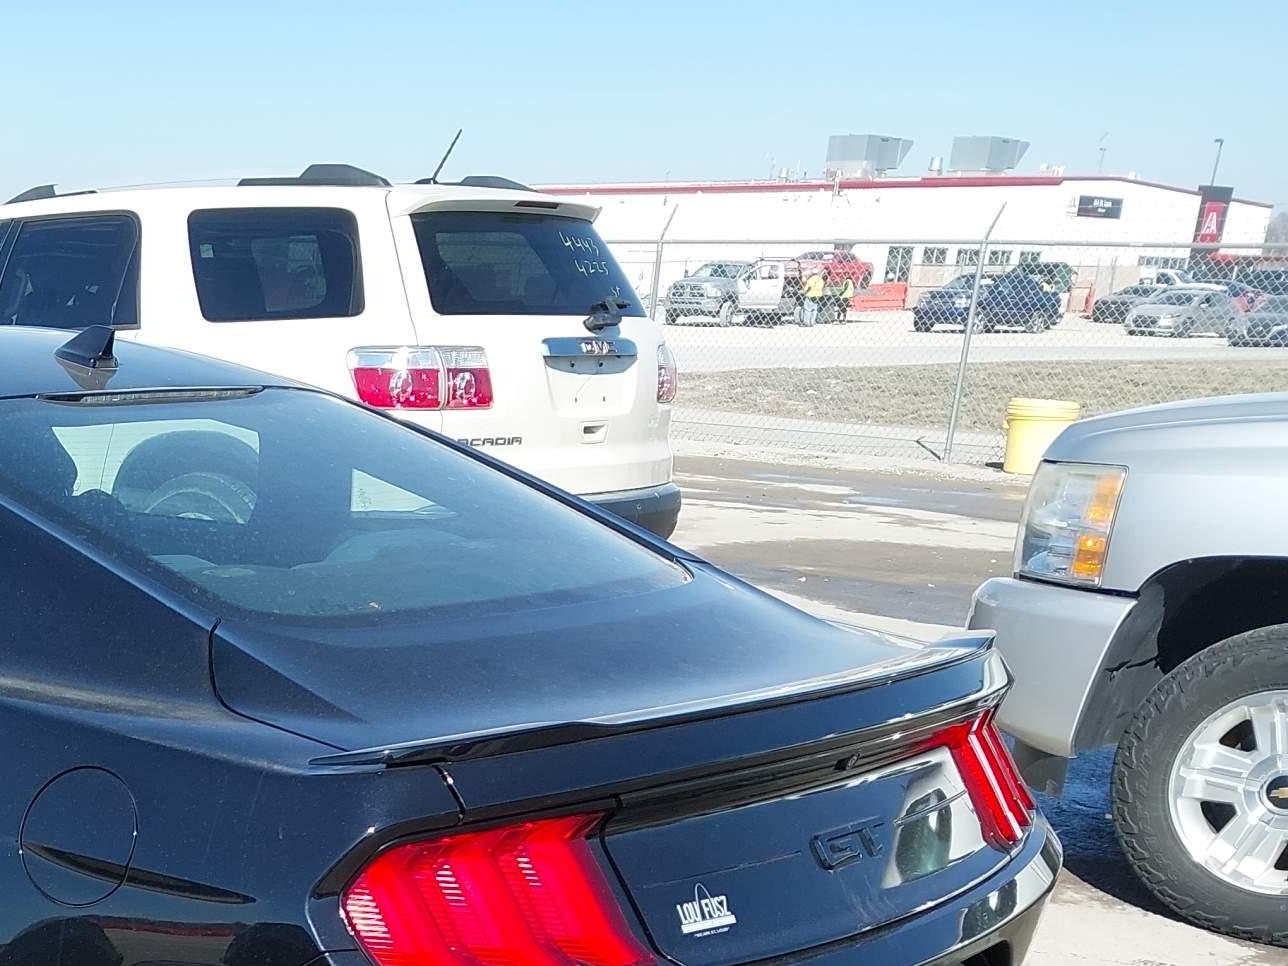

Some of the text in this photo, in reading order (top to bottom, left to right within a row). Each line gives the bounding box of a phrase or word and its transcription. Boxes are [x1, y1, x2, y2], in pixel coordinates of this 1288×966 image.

[558, 231, 599, 256] 4443
[574, 259, 609, 277] 4225
[809, 815, 886, 872] GT
[676, 895, 732, 925] LOU FUSZ
